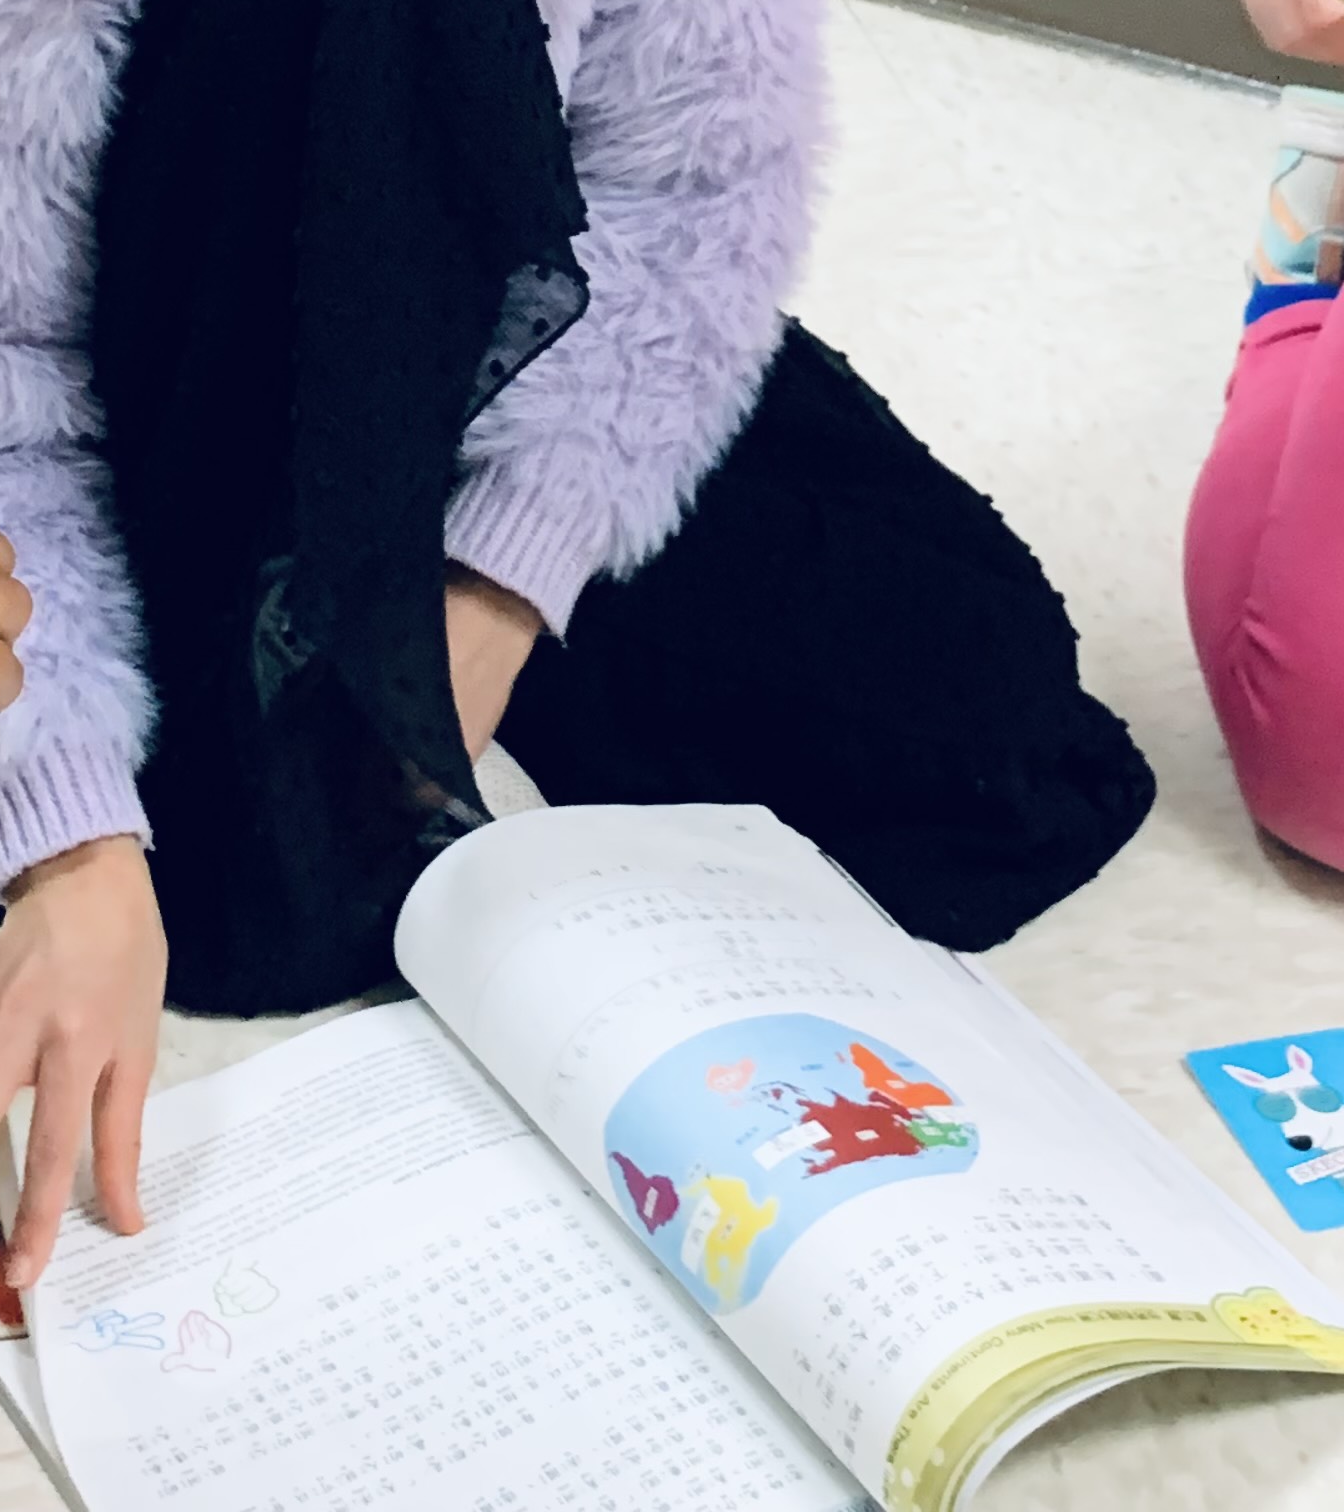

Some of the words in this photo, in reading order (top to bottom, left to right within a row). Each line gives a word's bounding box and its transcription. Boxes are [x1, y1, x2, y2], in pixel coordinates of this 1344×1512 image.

[1006, 1321, 1046, 1339] Many
[930, 1335, 1005, 1391] Continents
[908, 1392, 930, 1420] Are
